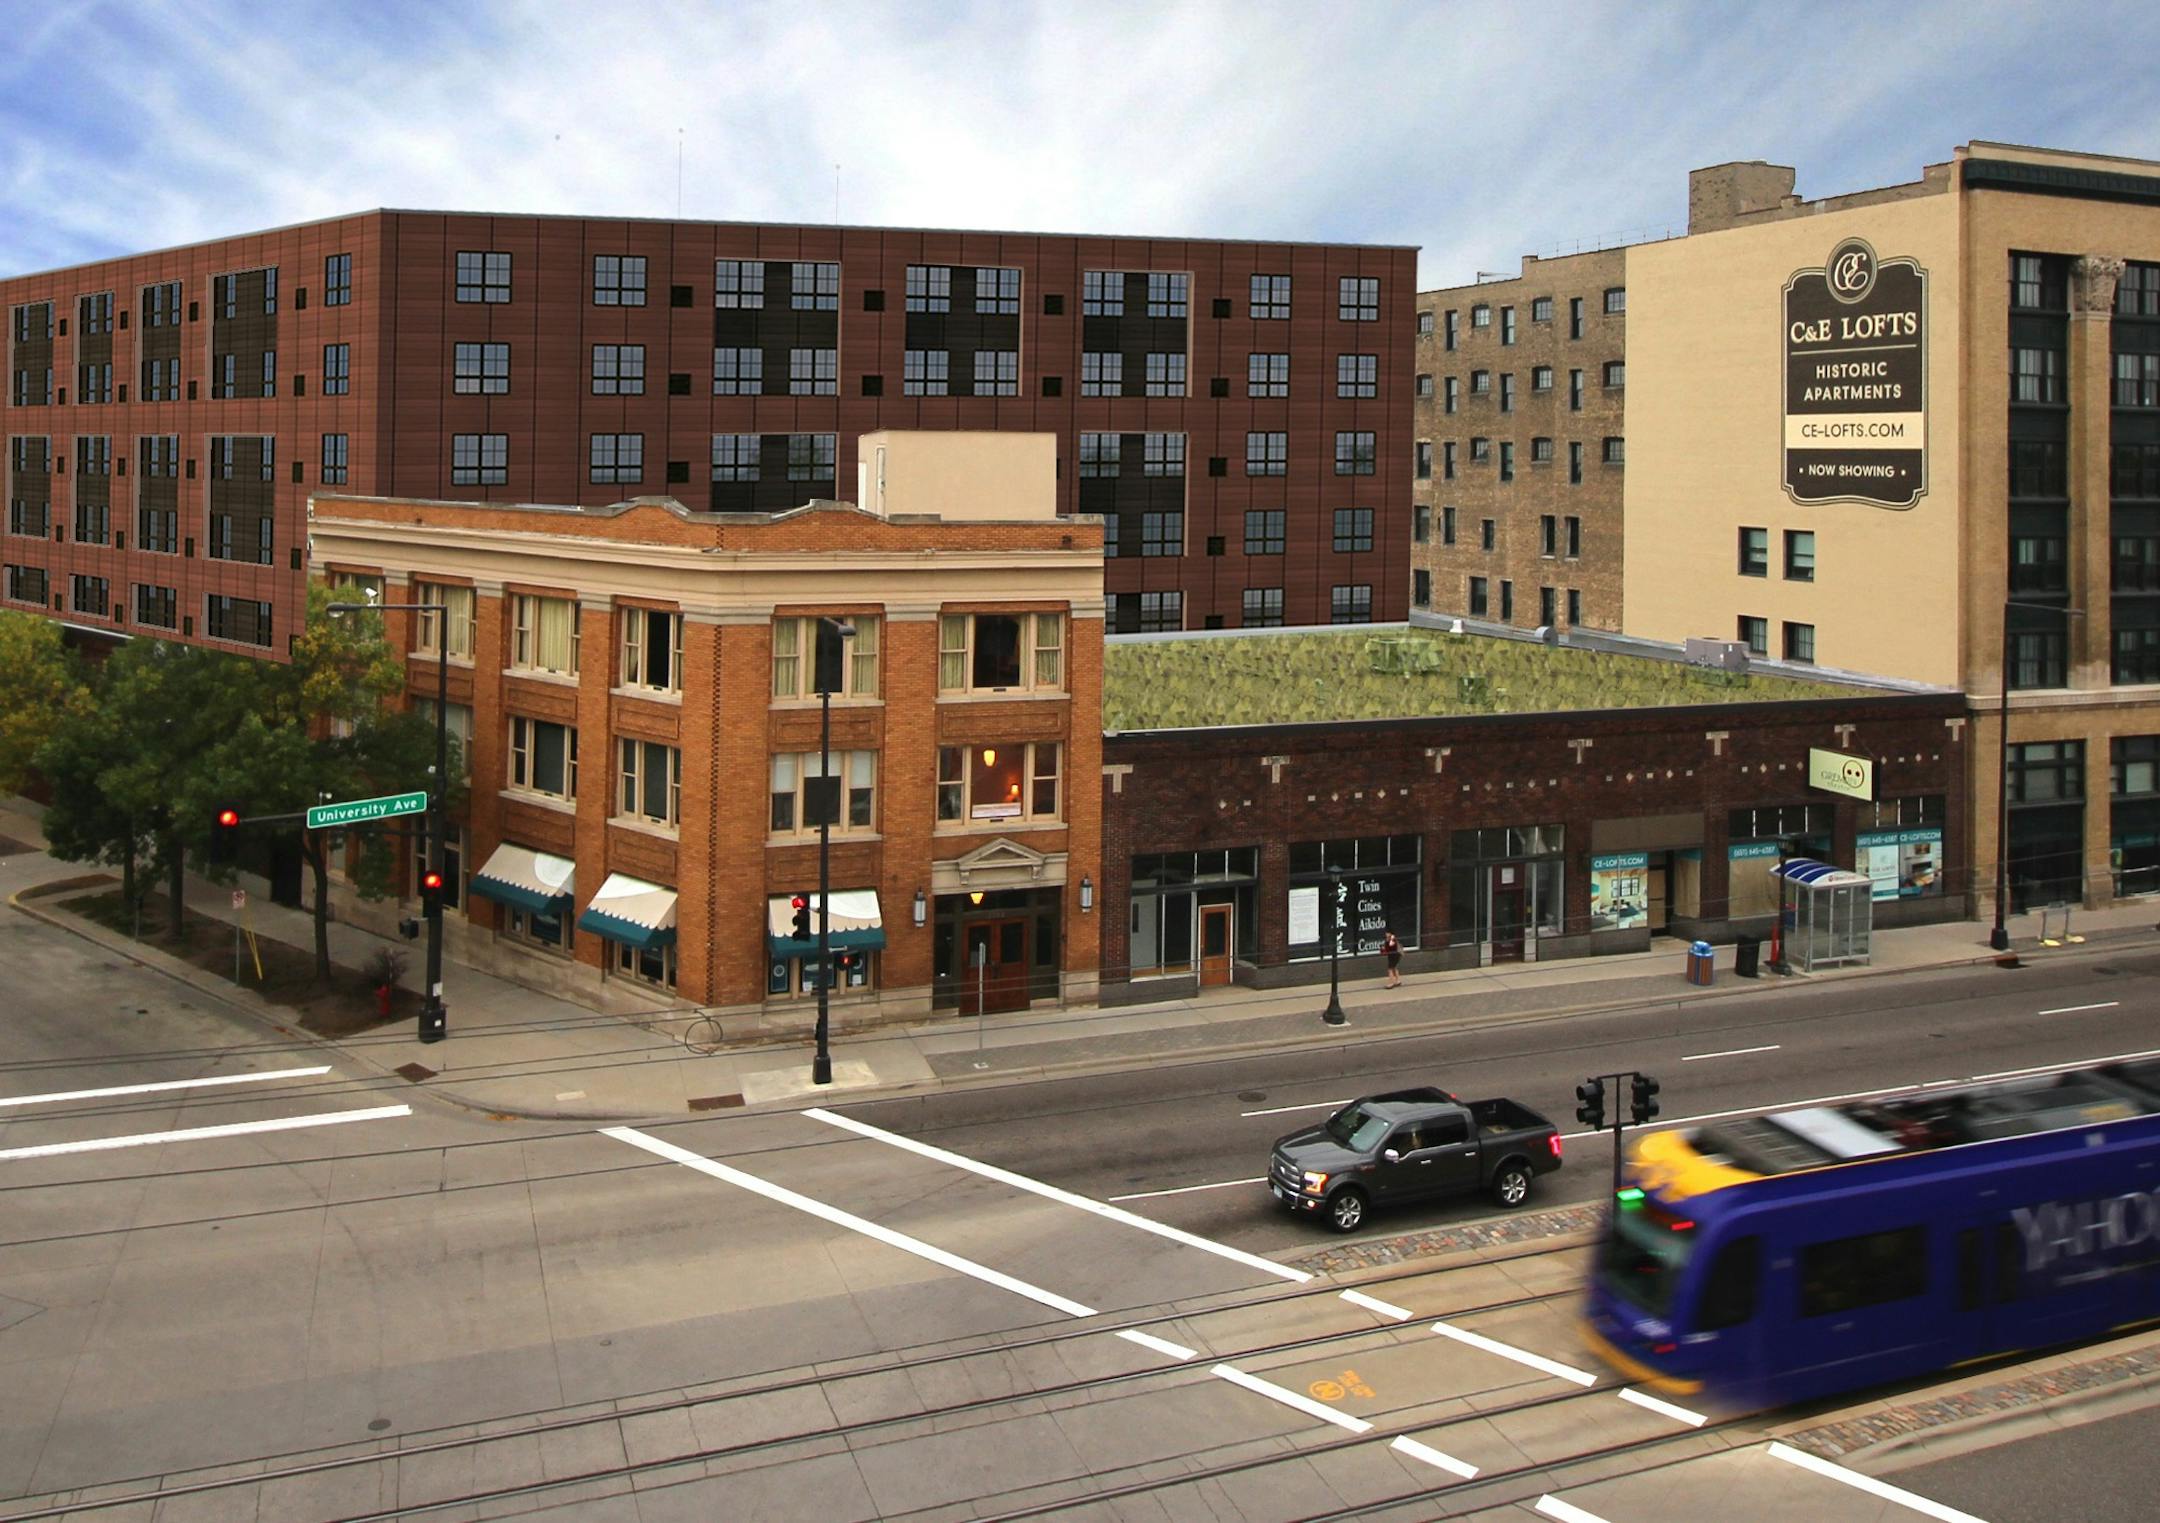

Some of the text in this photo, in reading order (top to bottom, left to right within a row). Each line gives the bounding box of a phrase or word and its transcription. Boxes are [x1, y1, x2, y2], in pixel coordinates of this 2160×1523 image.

[1790, 312, 1917, 343] C&E LOFTS
[1816, 361, 1888, 379] HISTORIC
[1803, 383, 1902, 402] APARTMENTS
[1801, 423, 1905, 438] CE-LOFTS.COM
[1808, 464, 1896, 478] NOW SHOWING
[317, 800, 418, 823] University Ave
[1358, 880, 1380, 893] Twin
[1358, 900, 1382, 913] Cities
[1359, 917, 1386, 931] Aikido
[2010, 1187, 2160, 1273] YAHO
